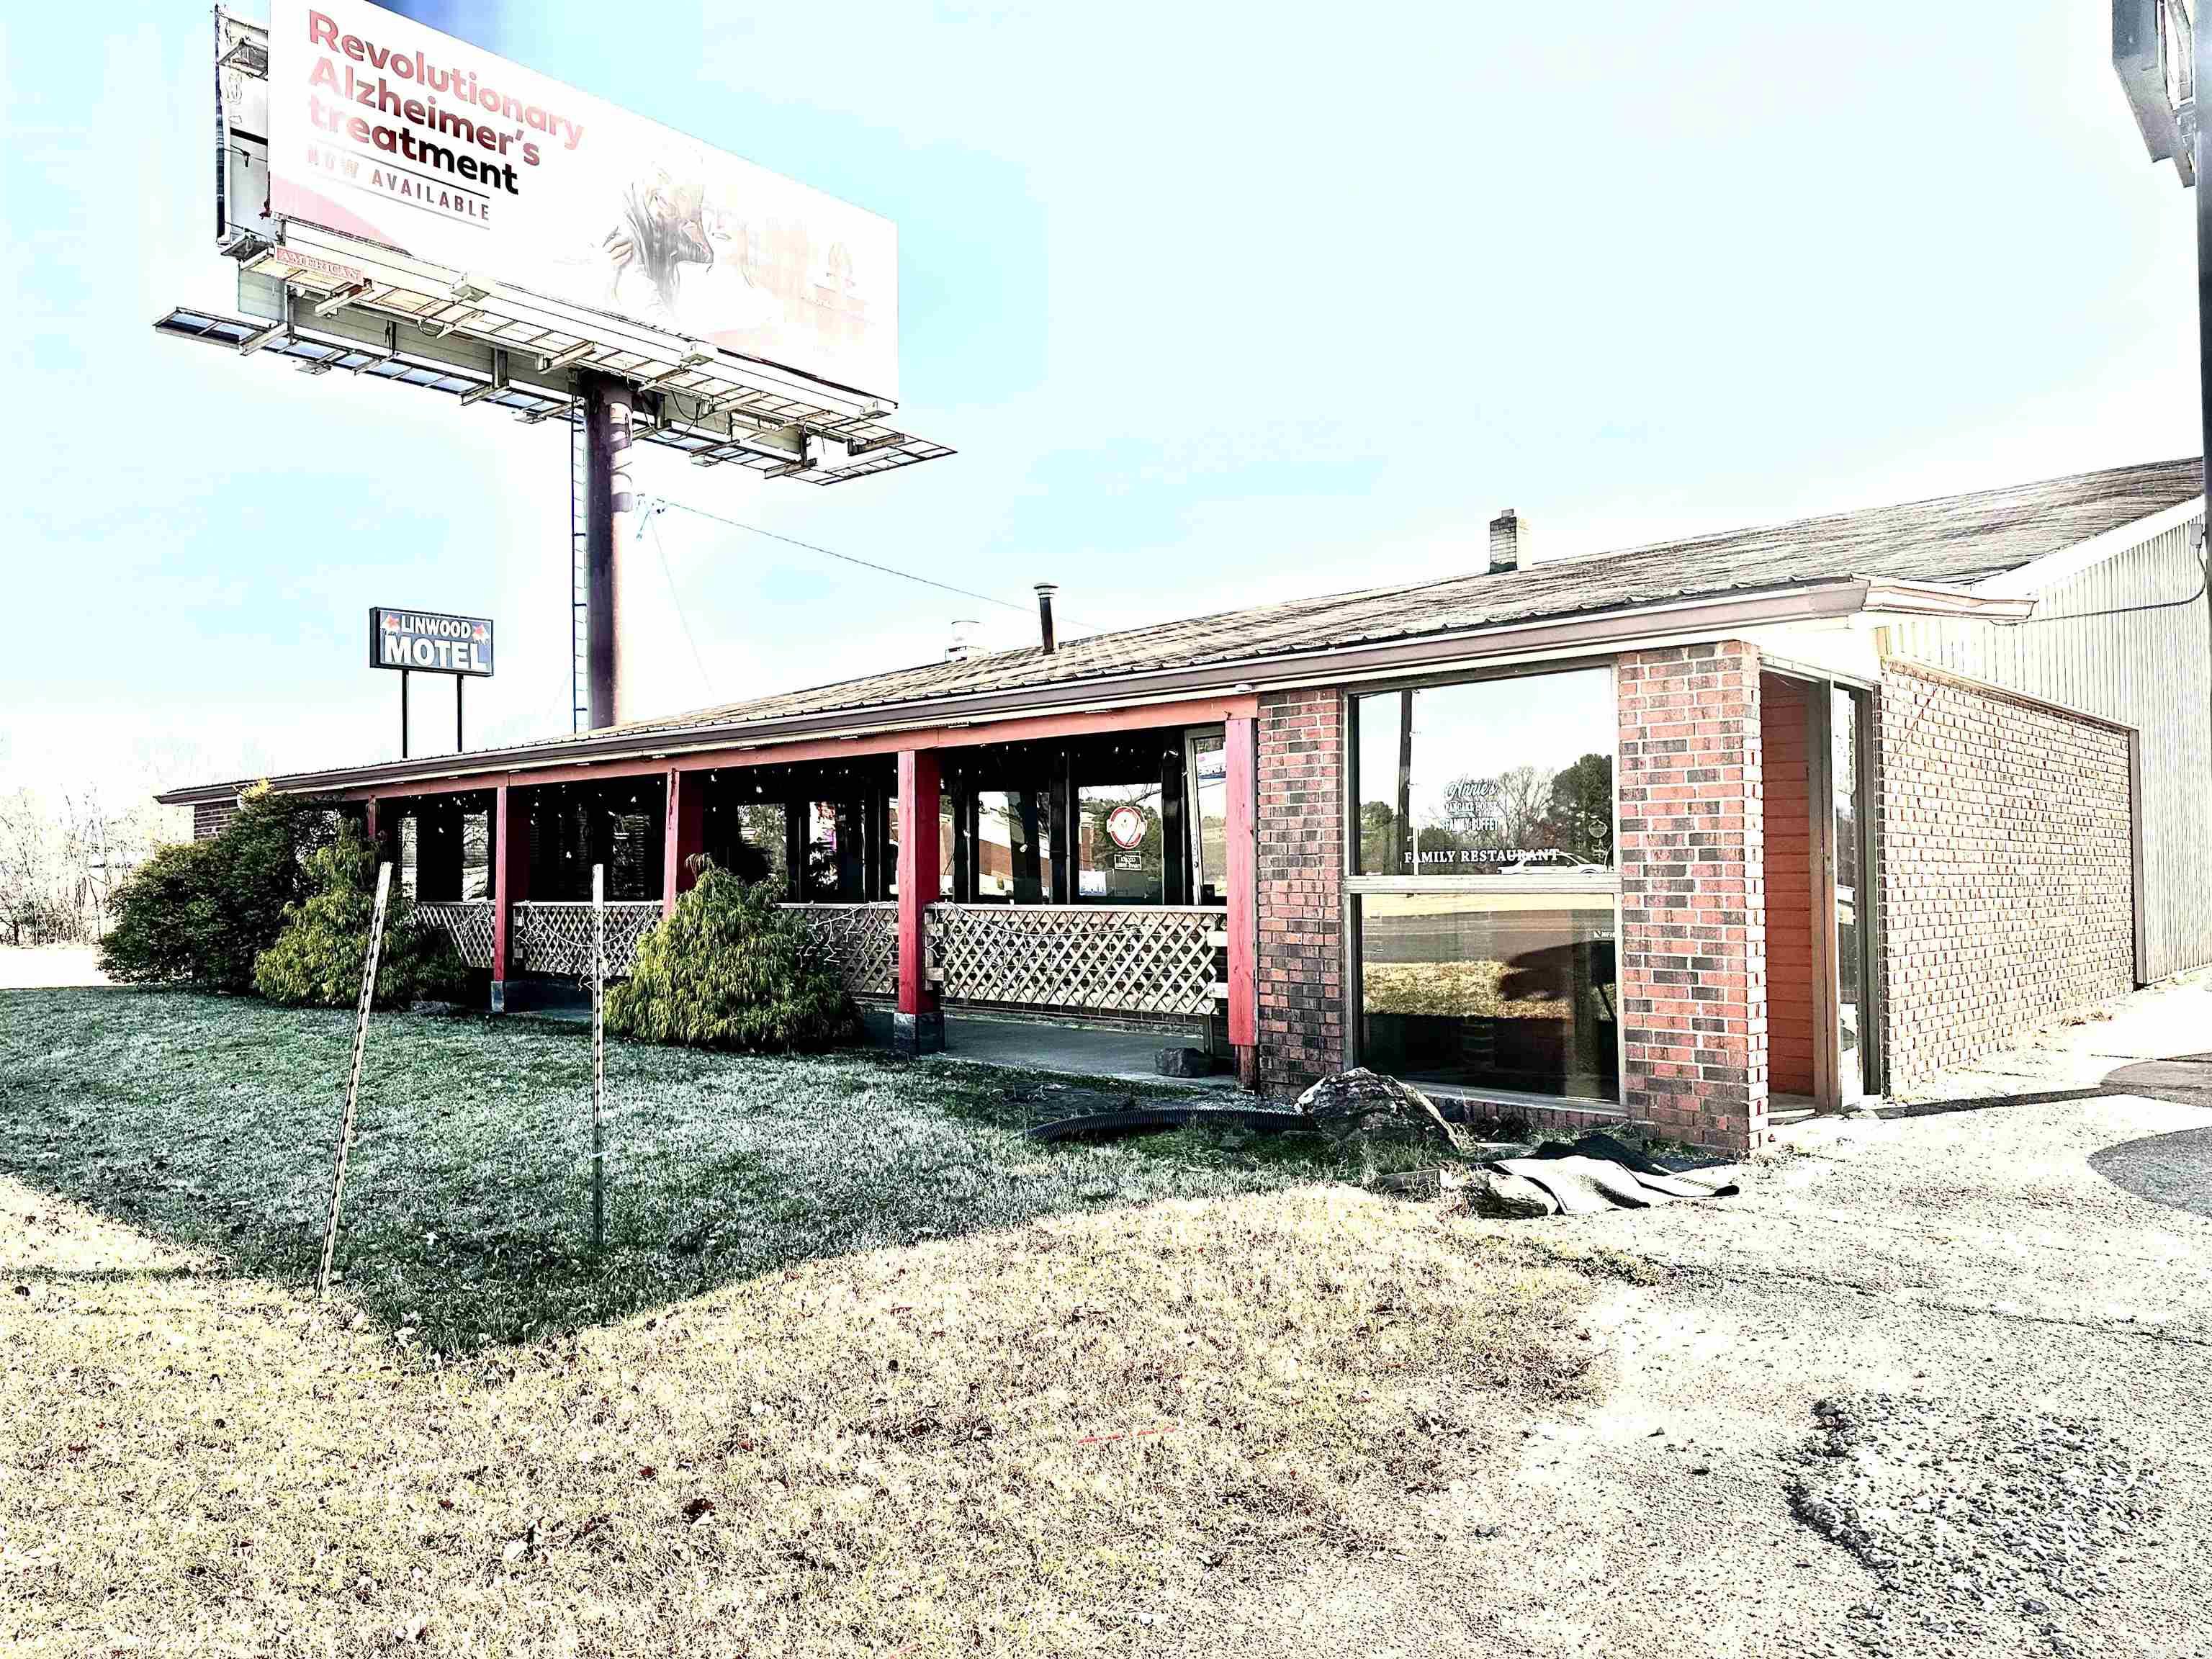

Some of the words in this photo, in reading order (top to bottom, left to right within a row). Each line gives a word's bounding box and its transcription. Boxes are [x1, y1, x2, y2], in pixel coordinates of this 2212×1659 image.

[309, 9, 585, 150] Revolutionary
[310, 55, 540, 166] Alzheimer's
[309, 93, 519, 195] treatment
[308, 145, 359, 179] NOW
[371, 168, 490, 220] AVAILABLE
[385, 634, 490, 671] MOTEL
[401, 615, 472, 639] LINWOOD
[1444, 774, 1498, 801] Annie's
[1404, 850, 1456, 863] FAMILY
[1460, 848, 1560, 863] RESTAURANT
